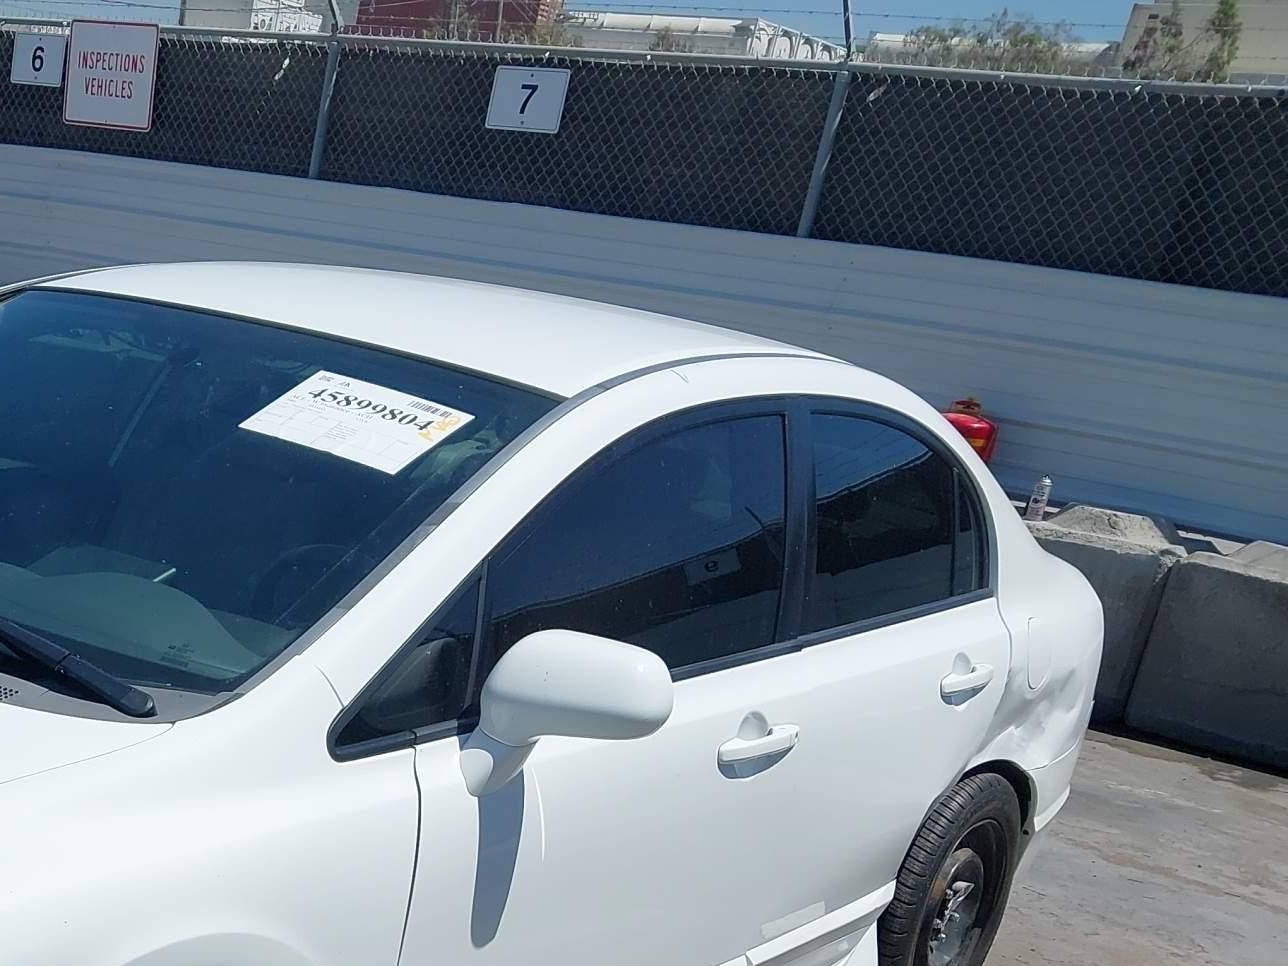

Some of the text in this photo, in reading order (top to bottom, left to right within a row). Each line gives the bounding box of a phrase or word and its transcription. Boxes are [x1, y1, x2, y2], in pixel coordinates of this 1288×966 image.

[31, 46, 45, 72] 6
[78, 51, 145, 74] INSPECTIONS
[84, 77, 134, 99] VEHICLES
[519, 84, 539, 114] 7
[308, 388, 435, 431] 45899804
